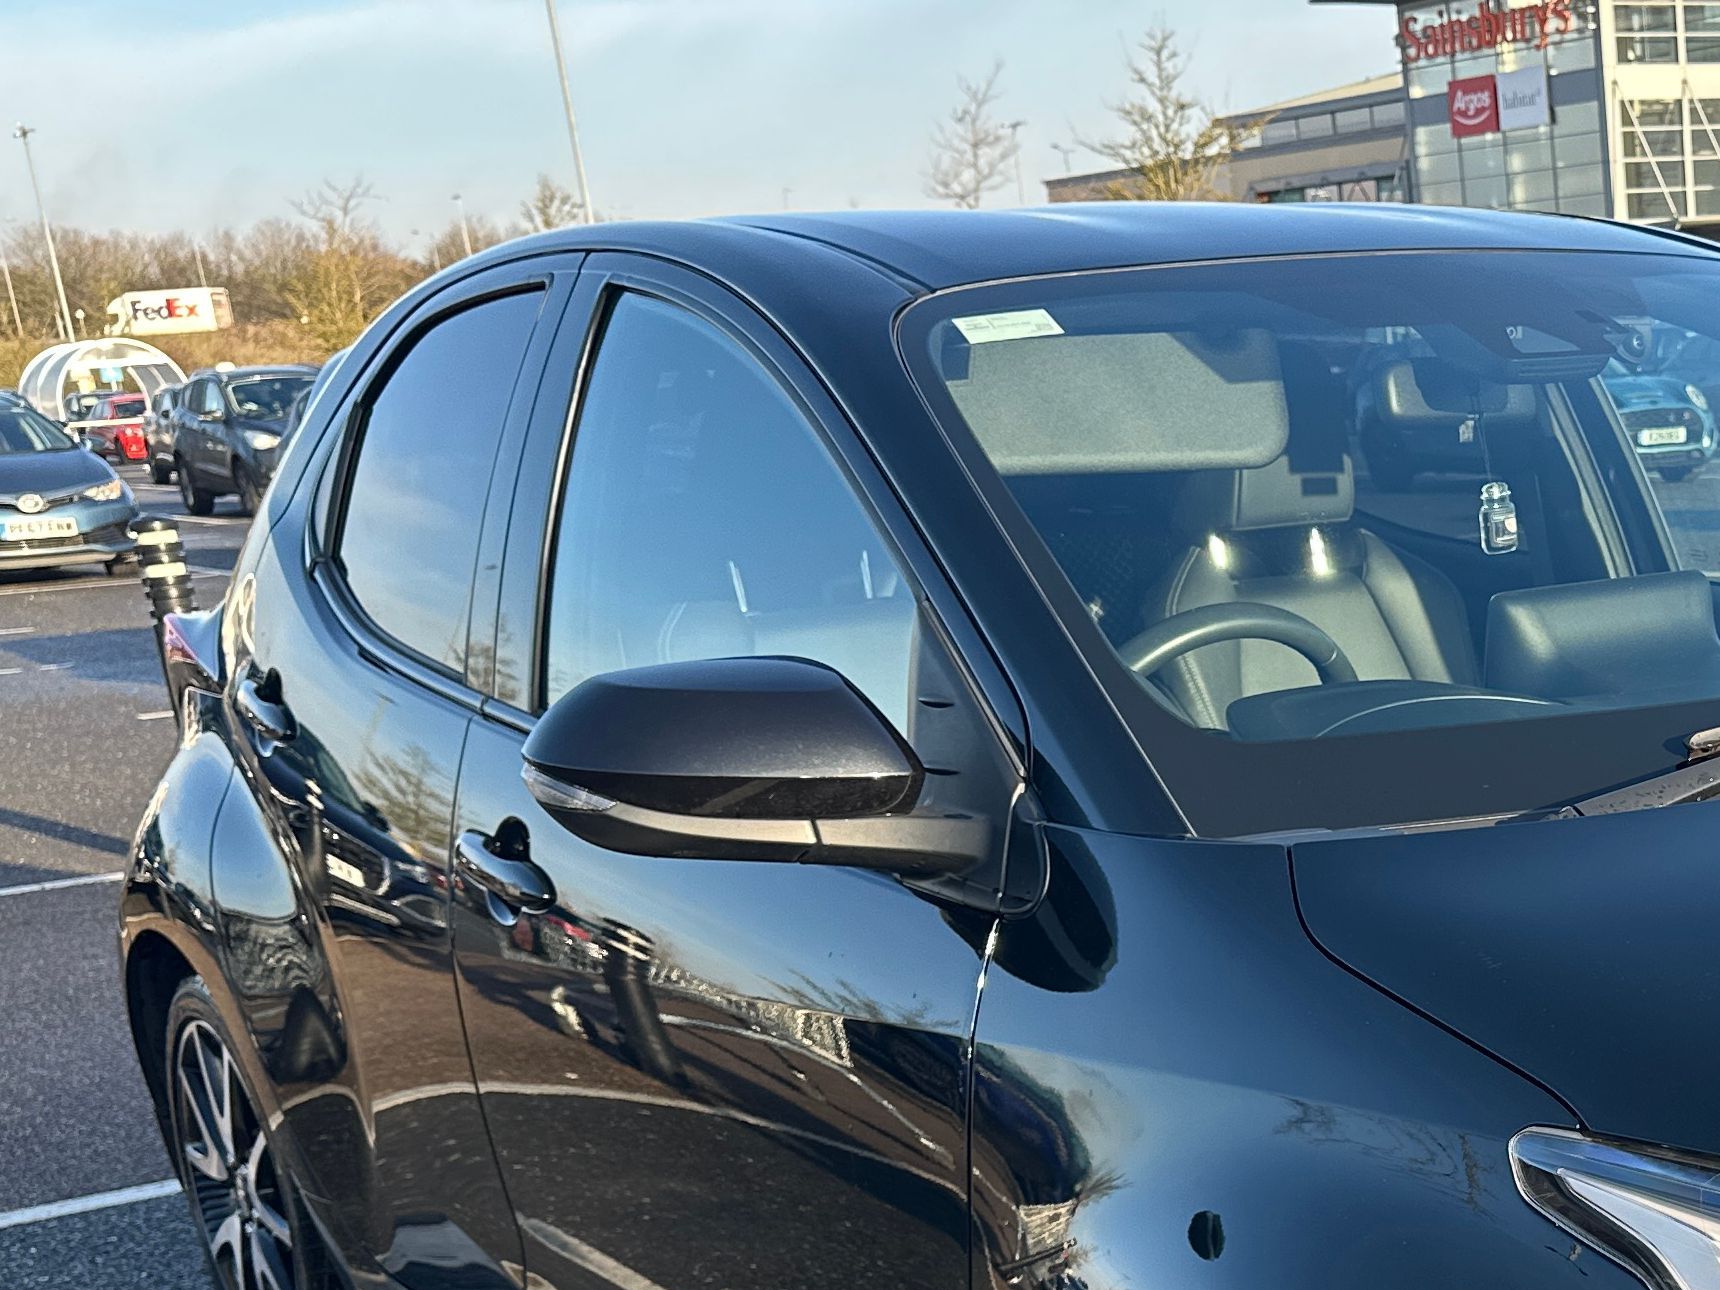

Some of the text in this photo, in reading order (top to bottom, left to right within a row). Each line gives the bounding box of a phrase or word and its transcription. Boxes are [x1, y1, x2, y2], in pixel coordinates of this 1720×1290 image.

[1402, 0, 1571, 62] Sainsburys
[1453, 89, 1491, 116] Argos
[130, 298, 199, 321] FedEx
